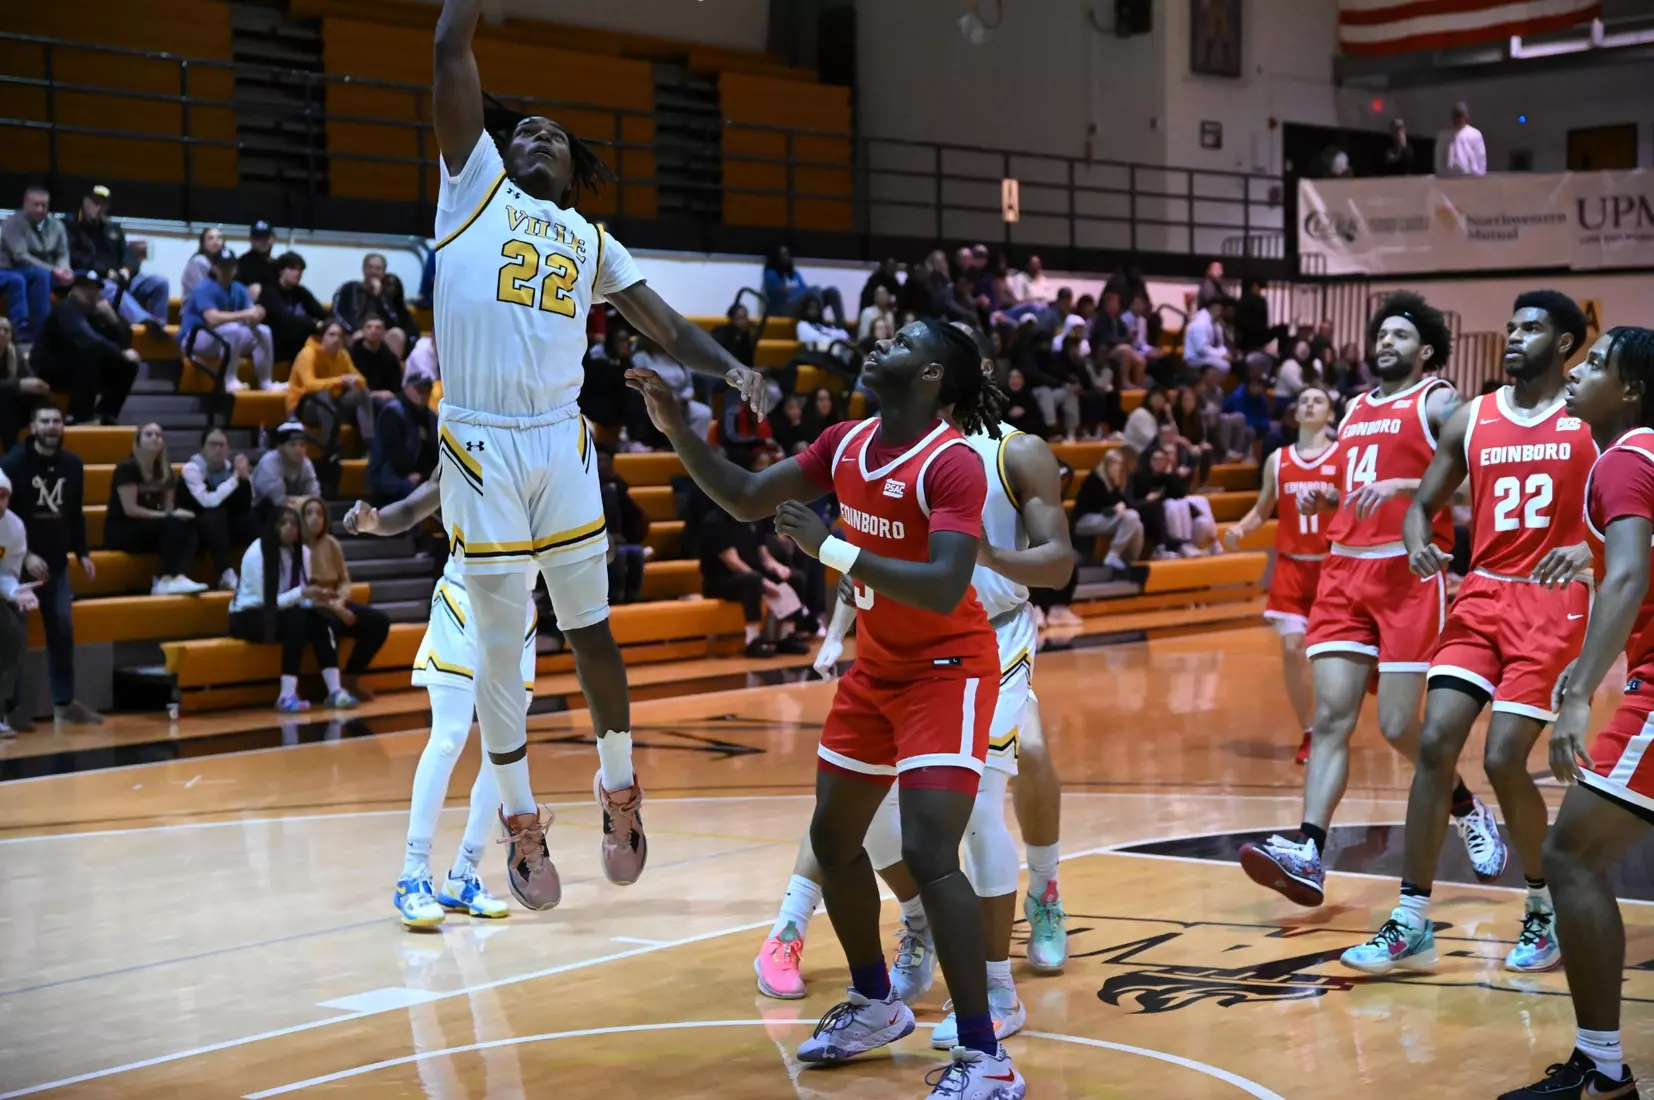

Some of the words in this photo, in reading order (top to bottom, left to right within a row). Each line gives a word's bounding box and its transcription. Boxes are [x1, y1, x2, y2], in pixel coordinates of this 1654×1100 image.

[505, 205, 587, 264] VILLE
[496, 238, 580, 319] 22
[1346, 443, 1379, 493] 14
[1480, 442, 1571, 466] EDINBORO
[31, 474, 66, 512] M
[884, 482, 906, 496] PSAC
[1493, 473, 1553, 532] 22
[840, 501, 905, 539] EDINBORO
